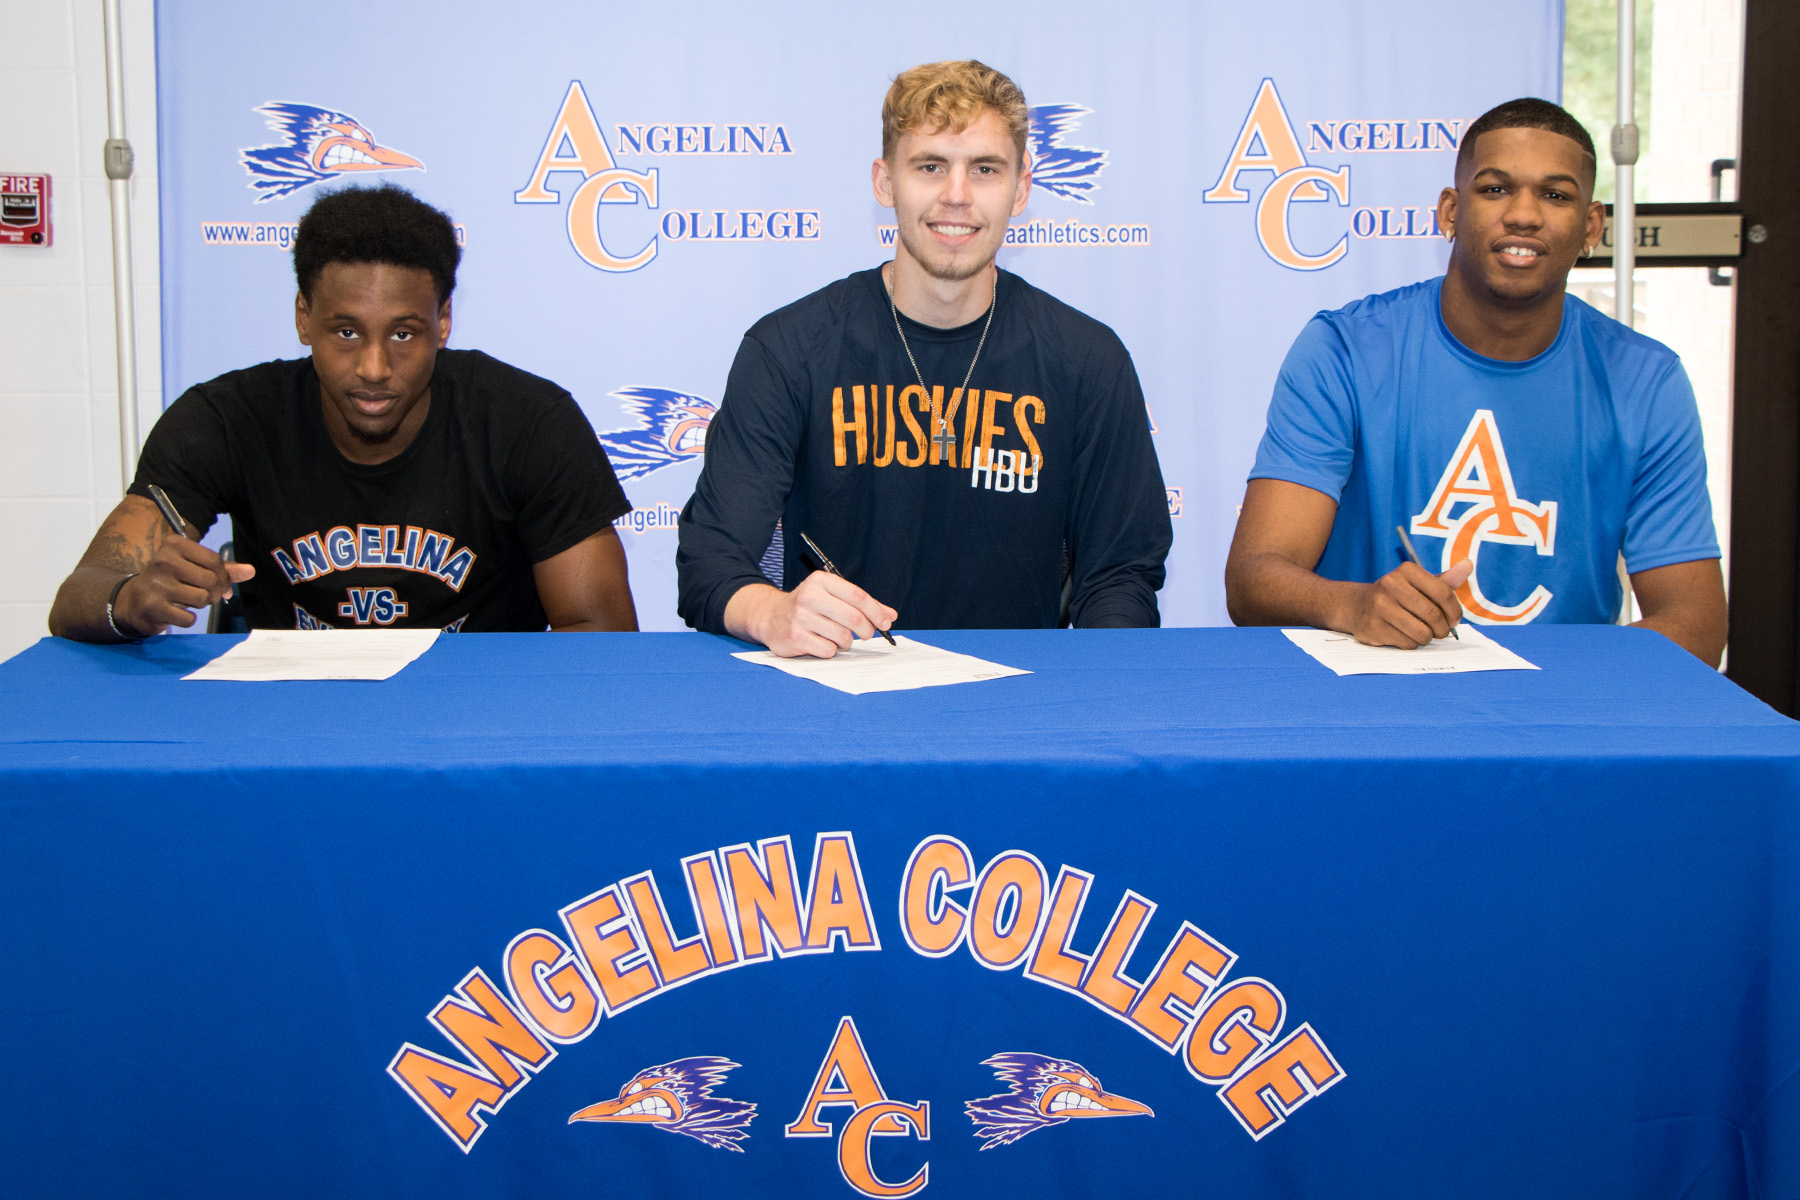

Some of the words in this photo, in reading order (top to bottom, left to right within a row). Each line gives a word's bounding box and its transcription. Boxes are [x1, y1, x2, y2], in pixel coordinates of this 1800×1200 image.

[0, 177, 40, 193] FIRE
[832, 384, 1046, 476] HUSKIES
[971, 446, 1039, 493] HBU
[271, 524, 477, 592] ANGELINA
[385, 831, 881, 1154] ANGELINA
[899, 834, 1347, 1141] COLLEGE
[785, 1016, 930, 1199] AC
